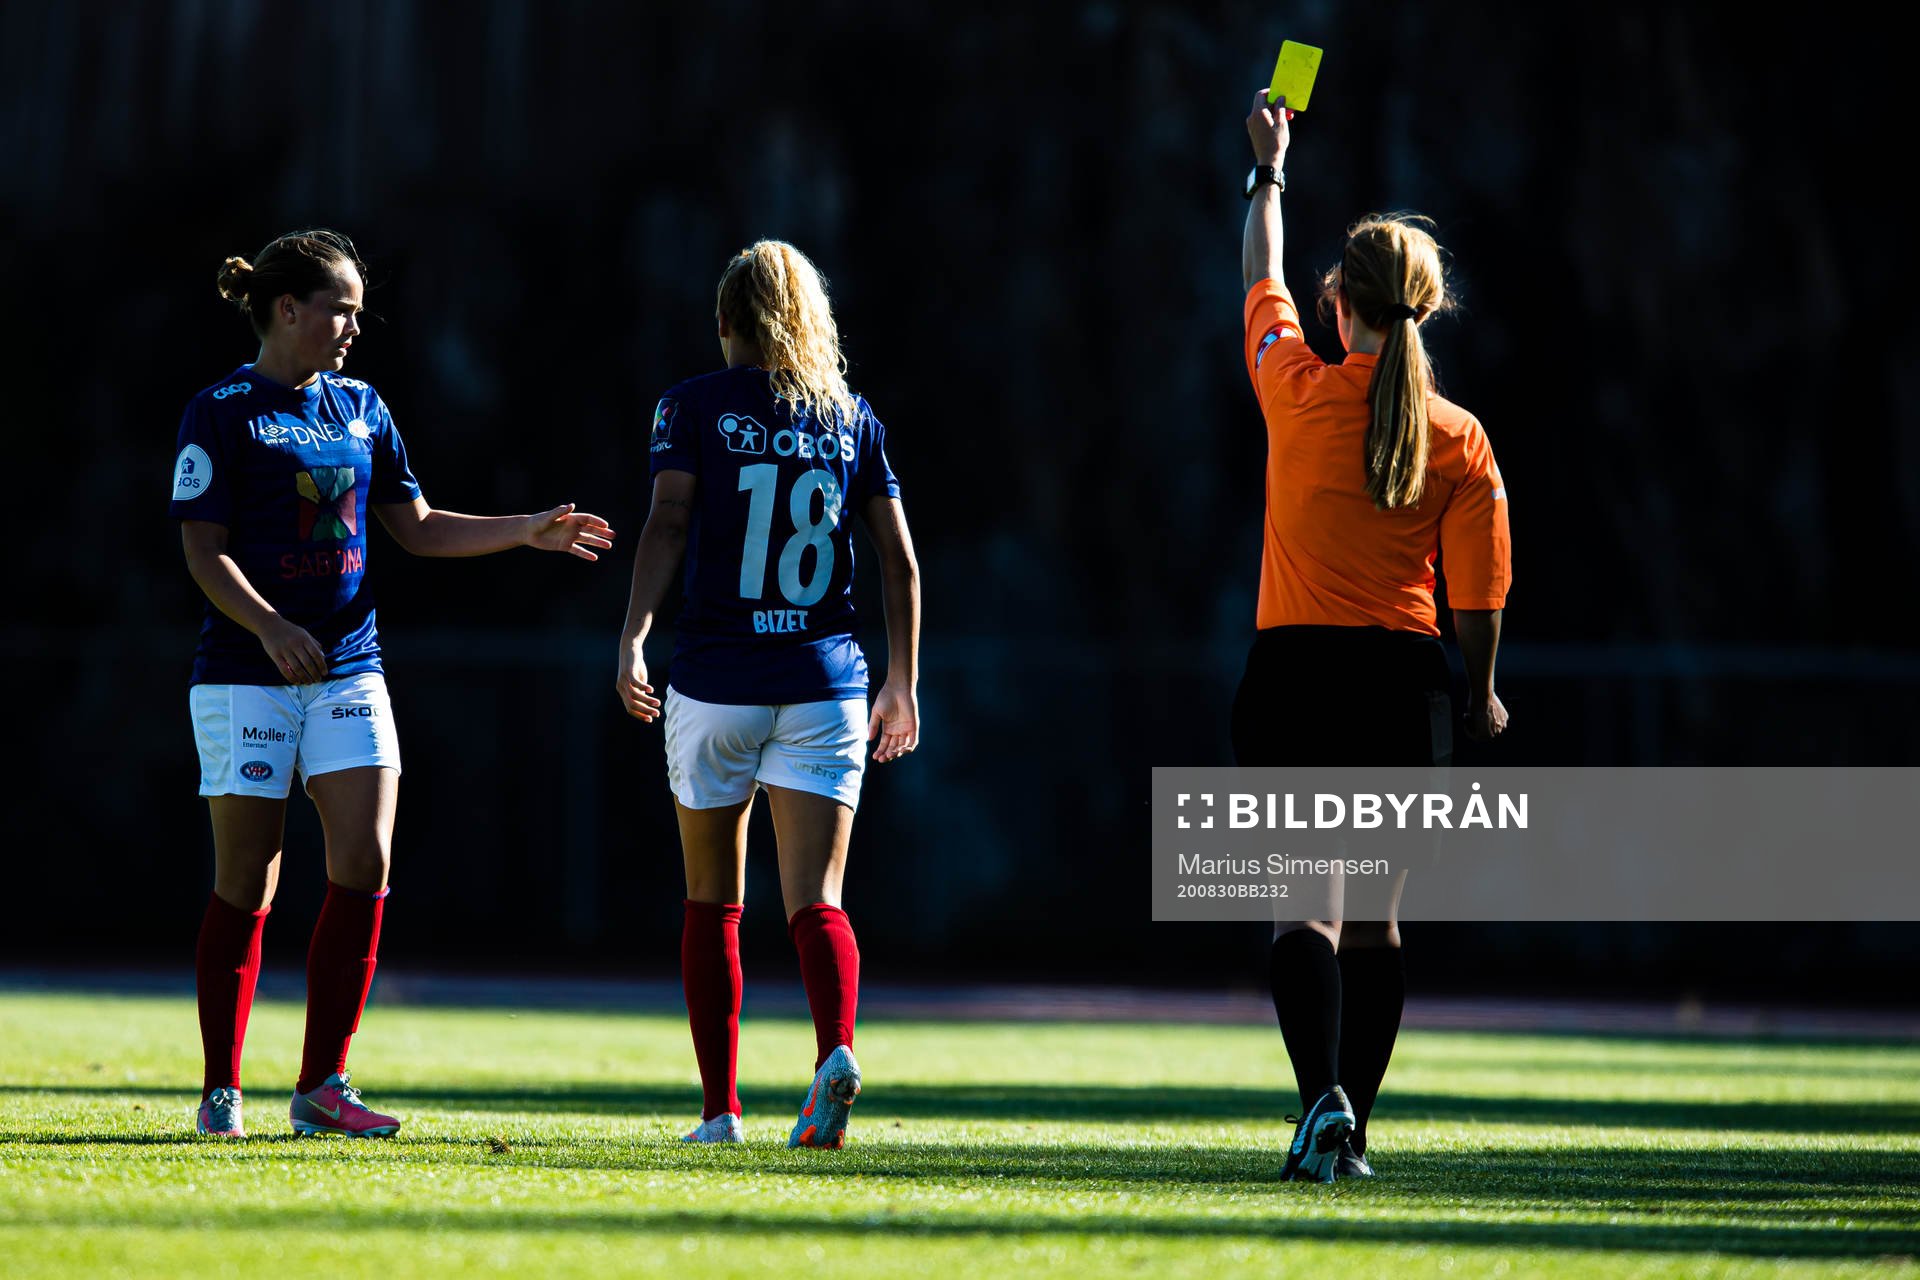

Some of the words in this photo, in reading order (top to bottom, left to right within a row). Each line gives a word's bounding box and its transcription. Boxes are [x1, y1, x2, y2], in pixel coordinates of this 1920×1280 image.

[291, 418, 344, 451] DNB
[773, 429, 856, 462] OBOS
[737, 463, 842, 607] 18
[753, 610, 809, 634] BIZET
